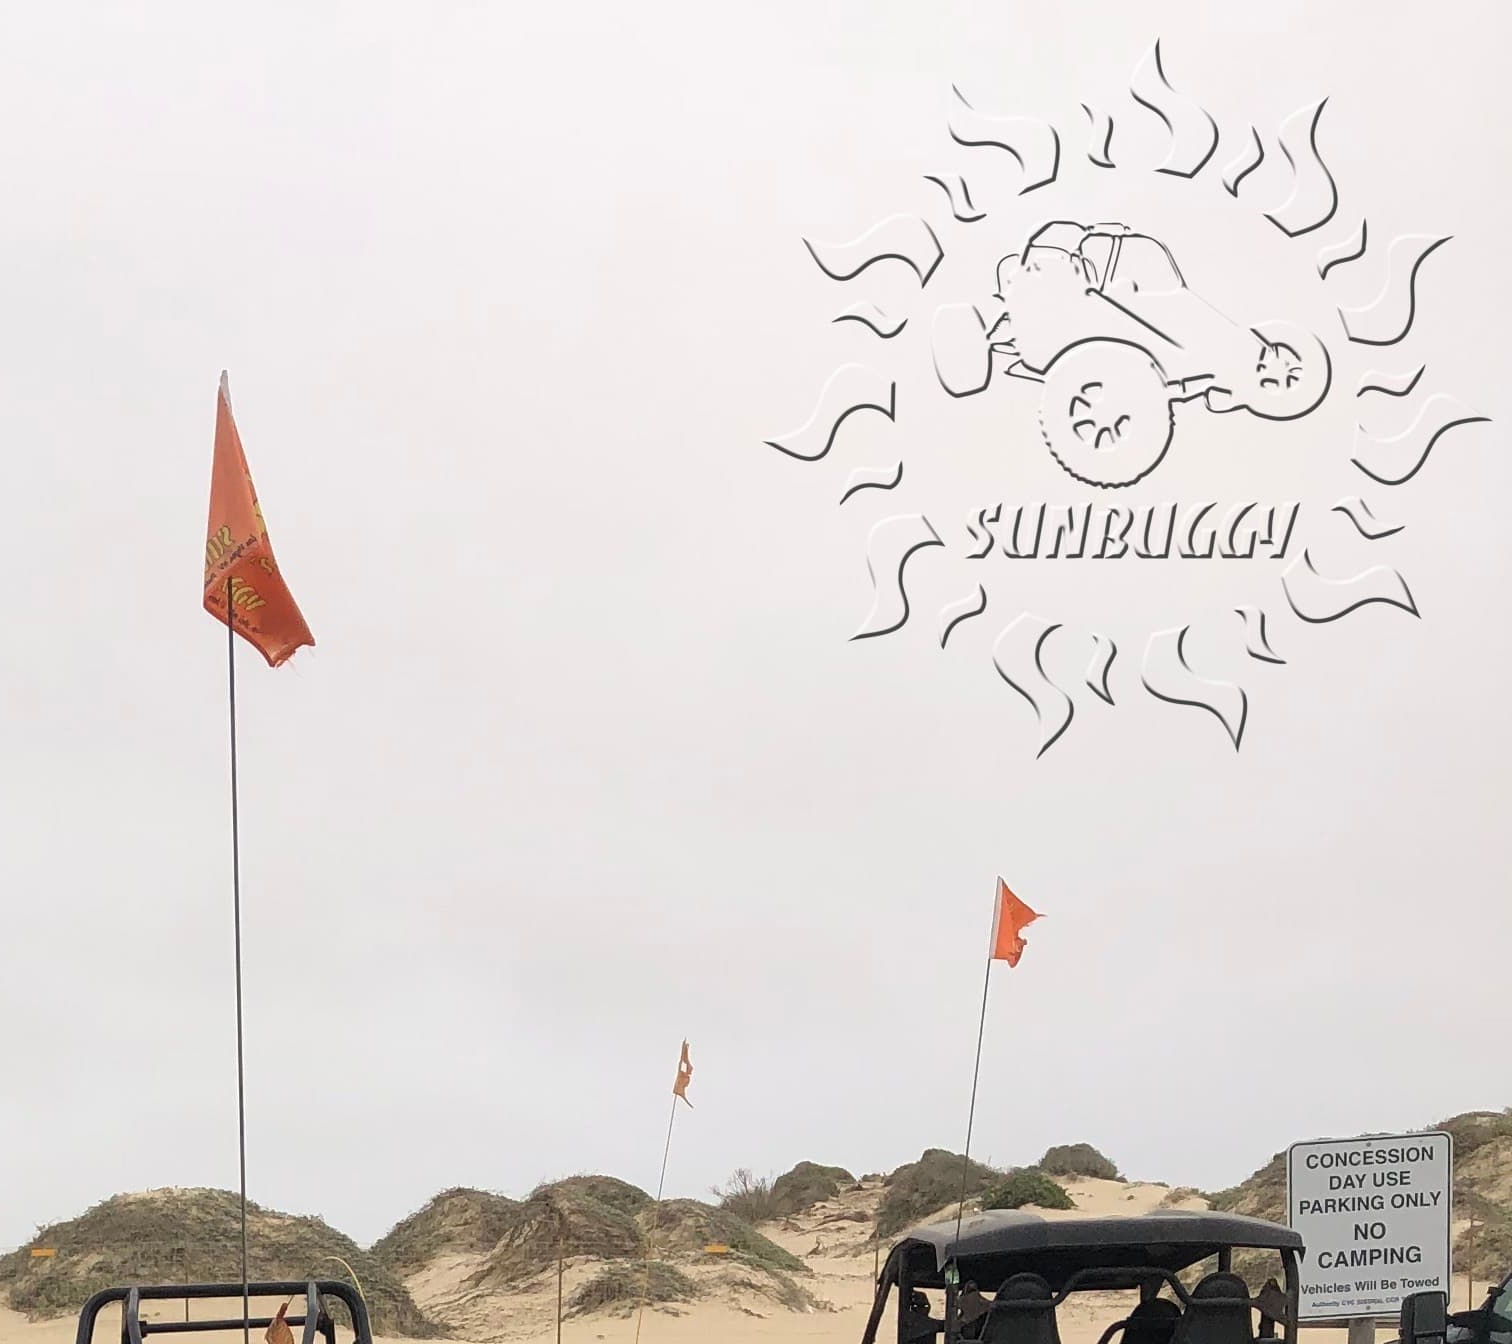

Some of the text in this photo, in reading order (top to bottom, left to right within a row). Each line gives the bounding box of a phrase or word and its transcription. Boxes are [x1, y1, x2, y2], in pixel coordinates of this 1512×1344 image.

[1306, 1146, 1434, 1169] CONCESSION
[1329, 1171, 1411, 1190] DAY USE
[1299, 1191, 1441, 1215] PARKING ONLY
[1354, 1222, 1387, 1240] NO
[1318, 1246, 1422, 1269] CAMPING
[1301, 1276, 1440, 1295] Vehicles Will Be Towed
